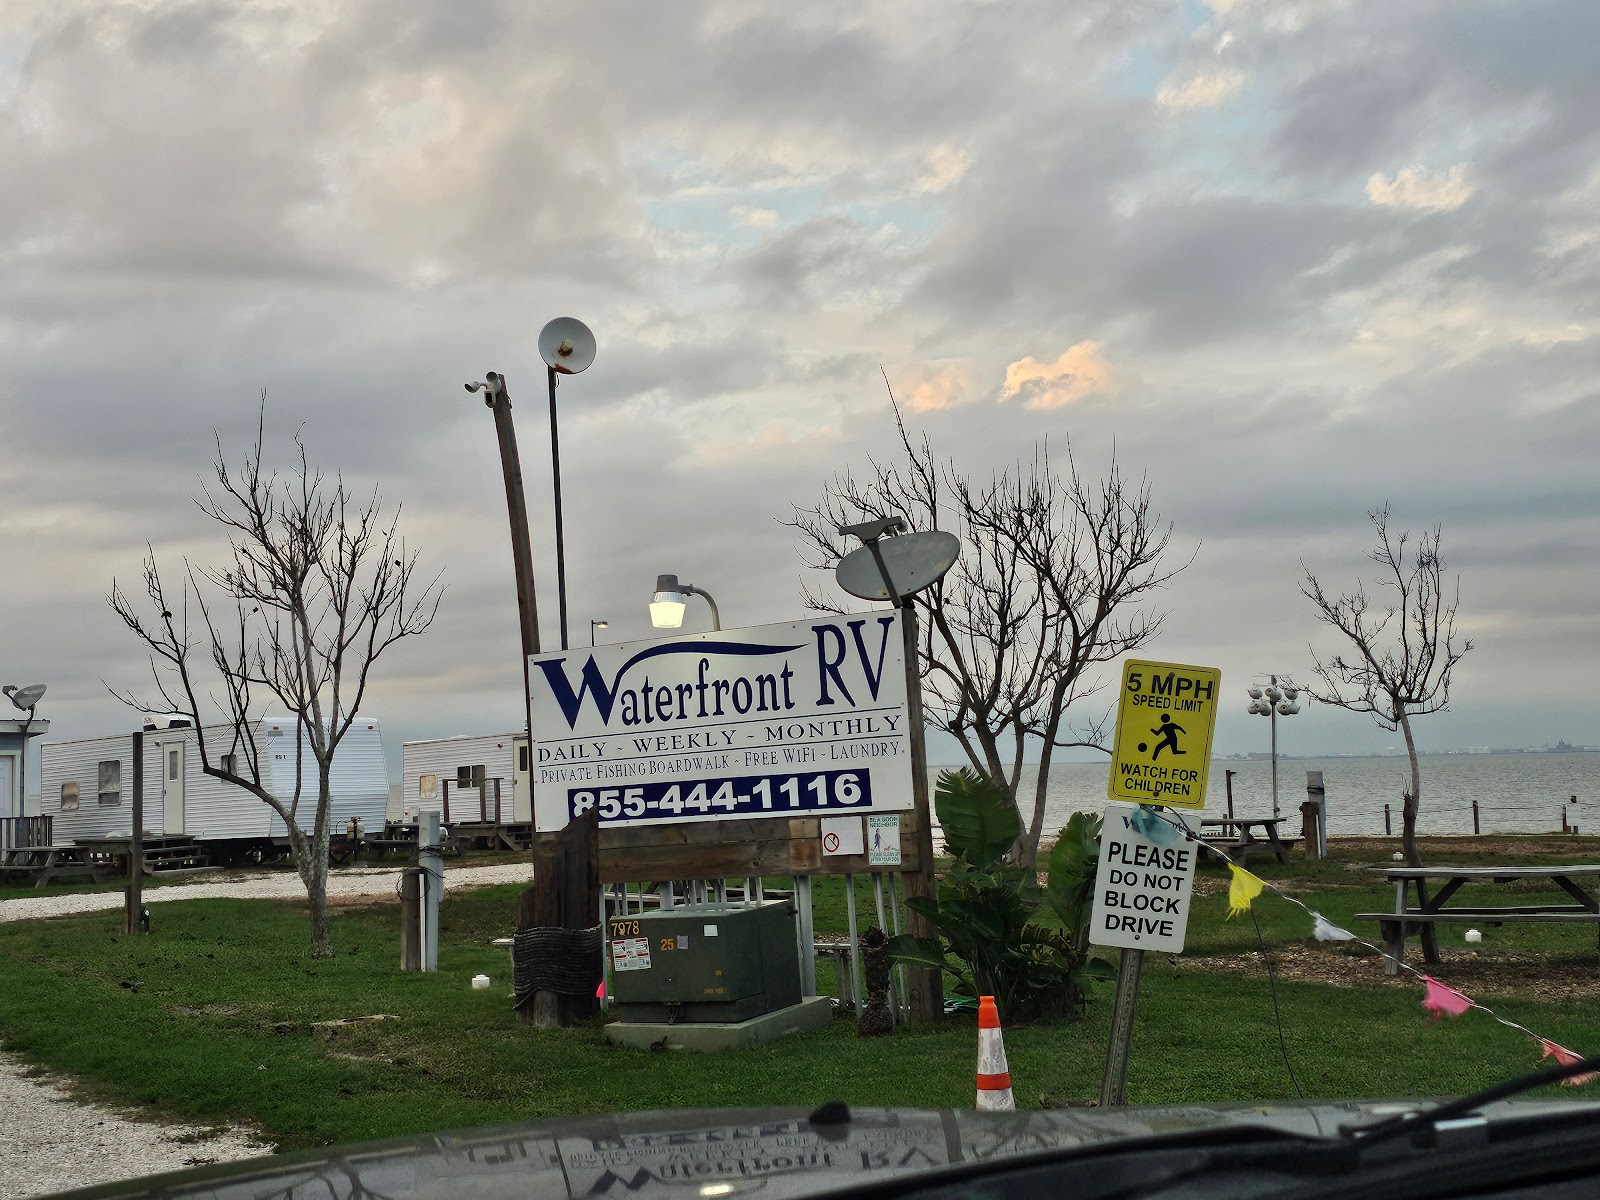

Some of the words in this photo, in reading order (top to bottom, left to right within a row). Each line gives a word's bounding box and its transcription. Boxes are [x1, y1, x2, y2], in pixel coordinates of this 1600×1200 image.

[533, 654, 795, 731] Waterfront
[811, 617, 895, 708] RV
[1127, 673, 1142, 692] 5
[1151, 674, 1213, 700] MPH
[1132, 693, 1171, 709] SPEED
[1174, 698, 1204, 713] LIMIT
[538, 742, 608, 763] DAILY
[633, 730, 737, 753] WEEKLY
[764, 715, 902, 742] MONTHLY
[541, 767, 593, 784] PRIVATE
[597, 762, 646, 780] FISHING
[649, 754, 730, 776] BOARDWALK
[744, 751, 779, 768] FREE
[782, 747, 816, 764] WIFI
[830, 741, 899, 760] LAUNDRY
[1120, 762, 1168, 780] WATCH
[1171, 769, 1199, 783] FOR
[573, 773, 862, 819] 855-444-1116
[1124, 777, 1191, 797] CHILDREN
[1107, 841, 1189, 871] PLEASE
[1109, 869, 1138, 887] DO
[1143, 873, 1184, 891] NOT
[1104, 890, 1181, 915] BLOCK
[611, 920, 640, 937] 7978
[1104, 913, 1174, 937] DRIVE
[660, 938, 675, 951] 25
